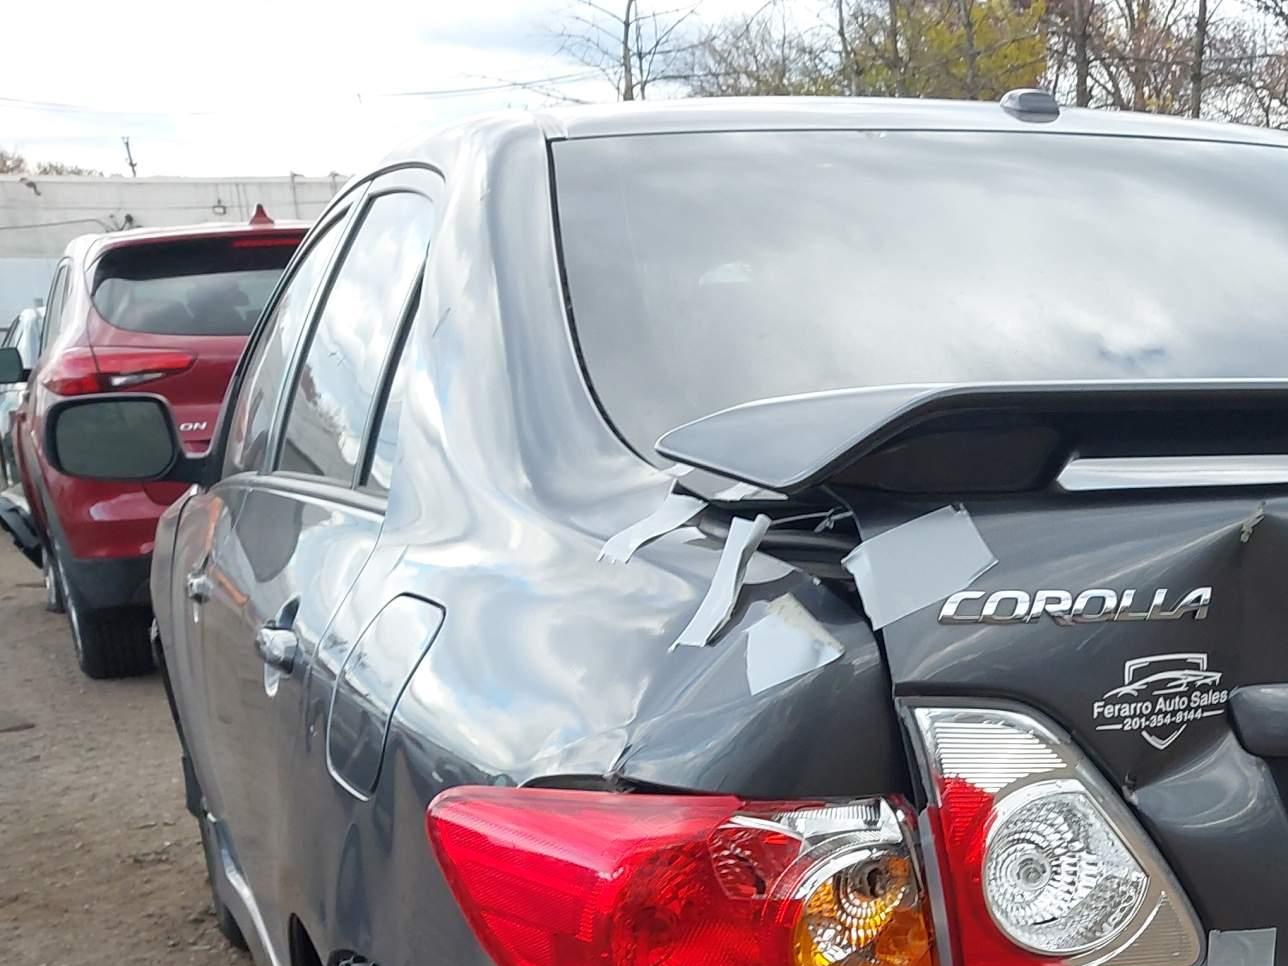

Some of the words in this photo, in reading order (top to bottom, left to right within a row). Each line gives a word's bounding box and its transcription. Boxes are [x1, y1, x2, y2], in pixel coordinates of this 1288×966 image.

[937, 586, 1213, 627] COROLLA
[1092, 700, 1153, 719] Ferarro
[1154, 695, 1188, 714] Auto
[1189, 689, 1229, 708] Sales
[1122, 707, 1203, 731] 201-354-8144
